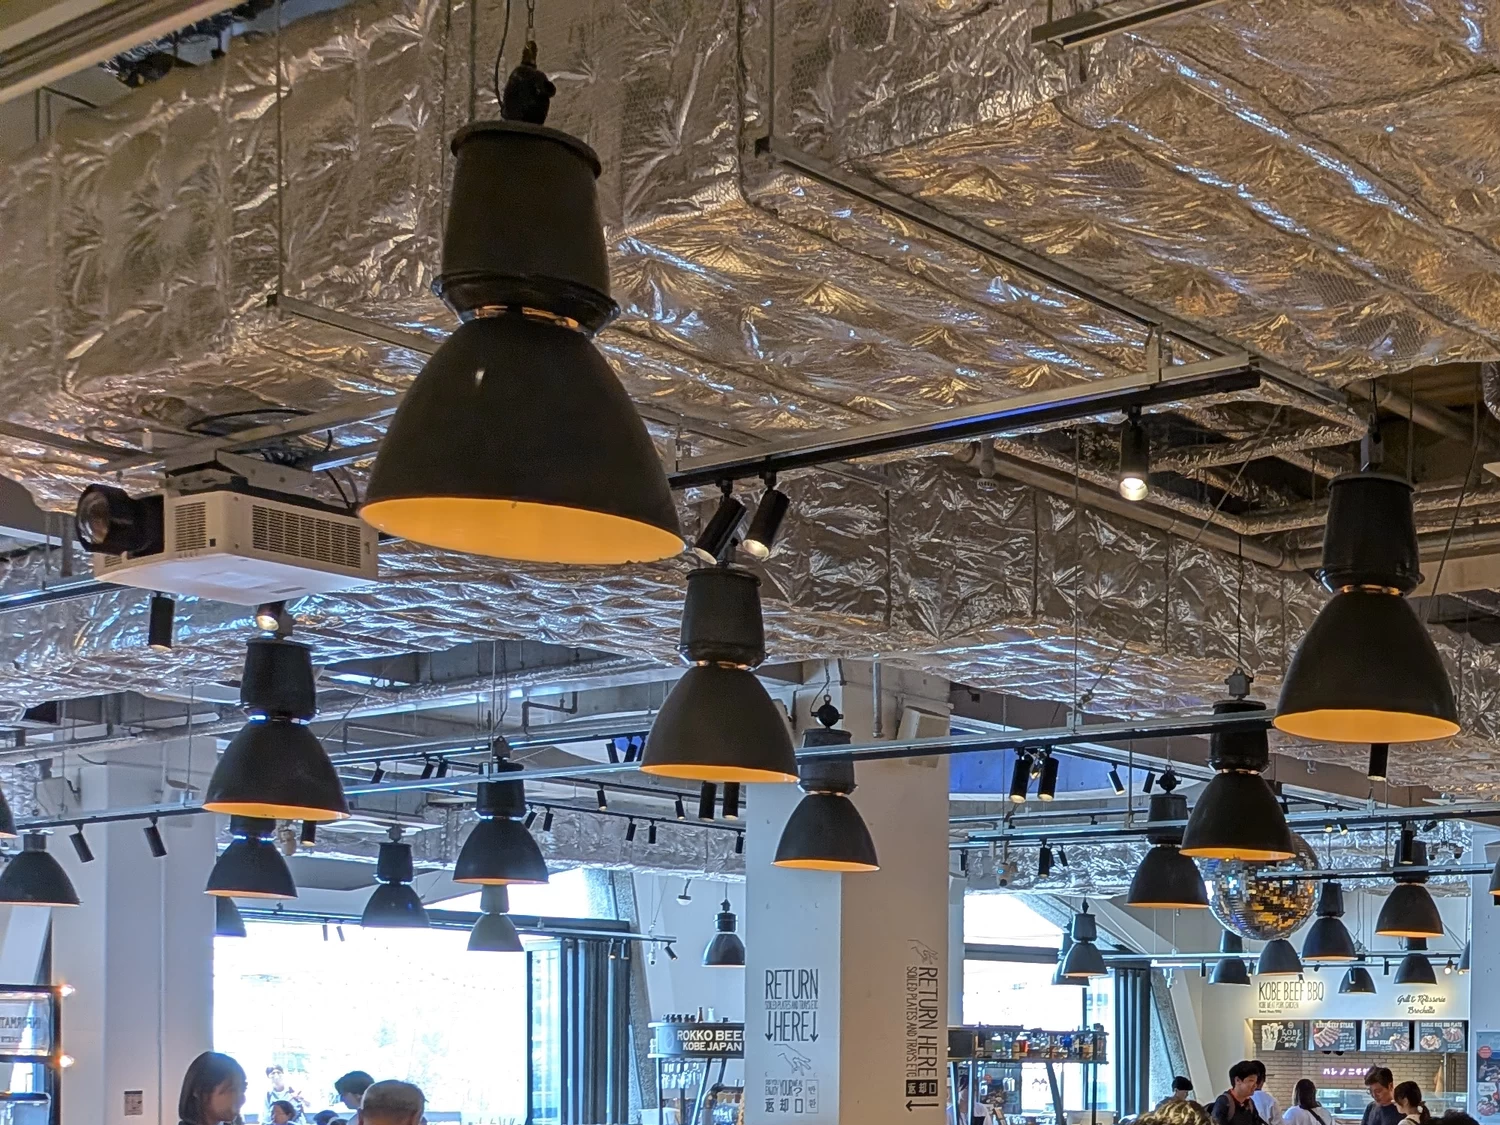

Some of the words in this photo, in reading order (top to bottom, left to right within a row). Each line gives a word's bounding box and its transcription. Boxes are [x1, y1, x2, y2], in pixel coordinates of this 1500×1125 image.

[765, 969, 819, 1000] RETURN
[906, 966, 918, 992] SOILED
[918, 966, 938, 1030] RETURN
[1259, 981, 1282, 1001] KOBE
[1284, 981, 1305, 1001] BEEF
[1307, 981, 1325, 1002] BBQ
[906, 993, 918, 1021] PLATES
[676, 1030, 713, 1041] ROKKO
[715, 1030, 745, 1041] BEE
[773, 1011, 809, 1042] HERE
[906, 1022, 918, 1037] AND
[682, 1042, 706, 1051] KOBE
[707, 1042, 742, 1051] JAPAN
[917, 1035, 938, 1077] HERE
[906, 1063, 918, 1078] ETC
[765, 1098, 803, 1114] 返却口
